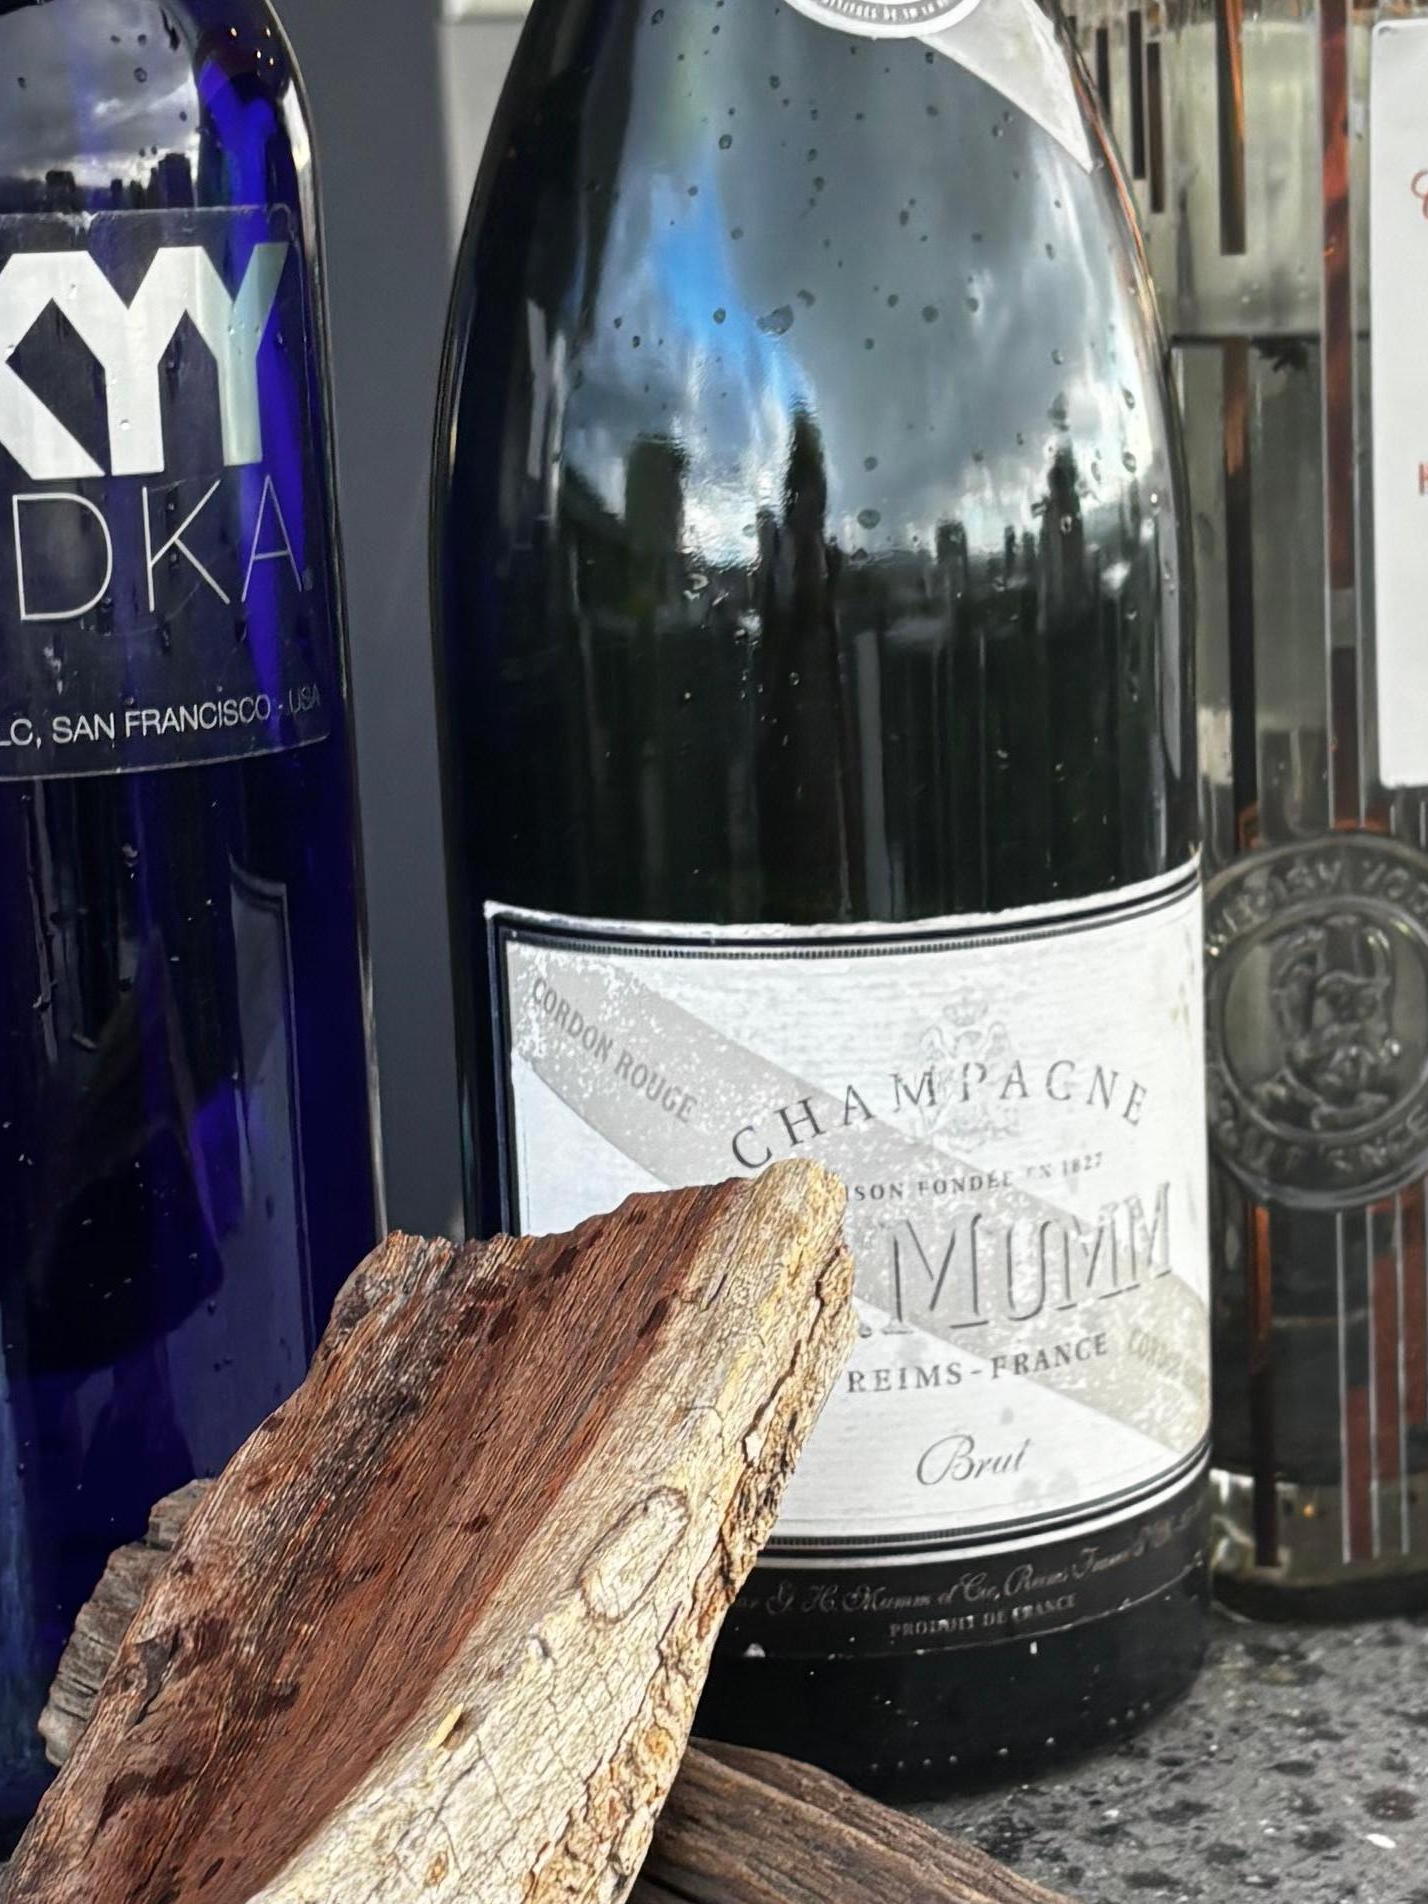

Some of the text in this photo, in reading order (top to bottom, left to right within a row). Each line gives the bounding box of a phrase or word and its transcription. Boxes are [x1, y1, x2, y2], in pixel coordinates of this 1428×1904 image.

[52, 712, 115, 744] SAN
[125, 694, 271, 738] FRANCISCO
[288, 684, 321, 713] USA
[532, 977, 699, 1124] CORDON ROUGE
[731, 1058, 1148, 1171] CHAMPAGNE
[844, 1182, 904, 1203] ISON
[916, 1434, 1032, 1486] Brut
